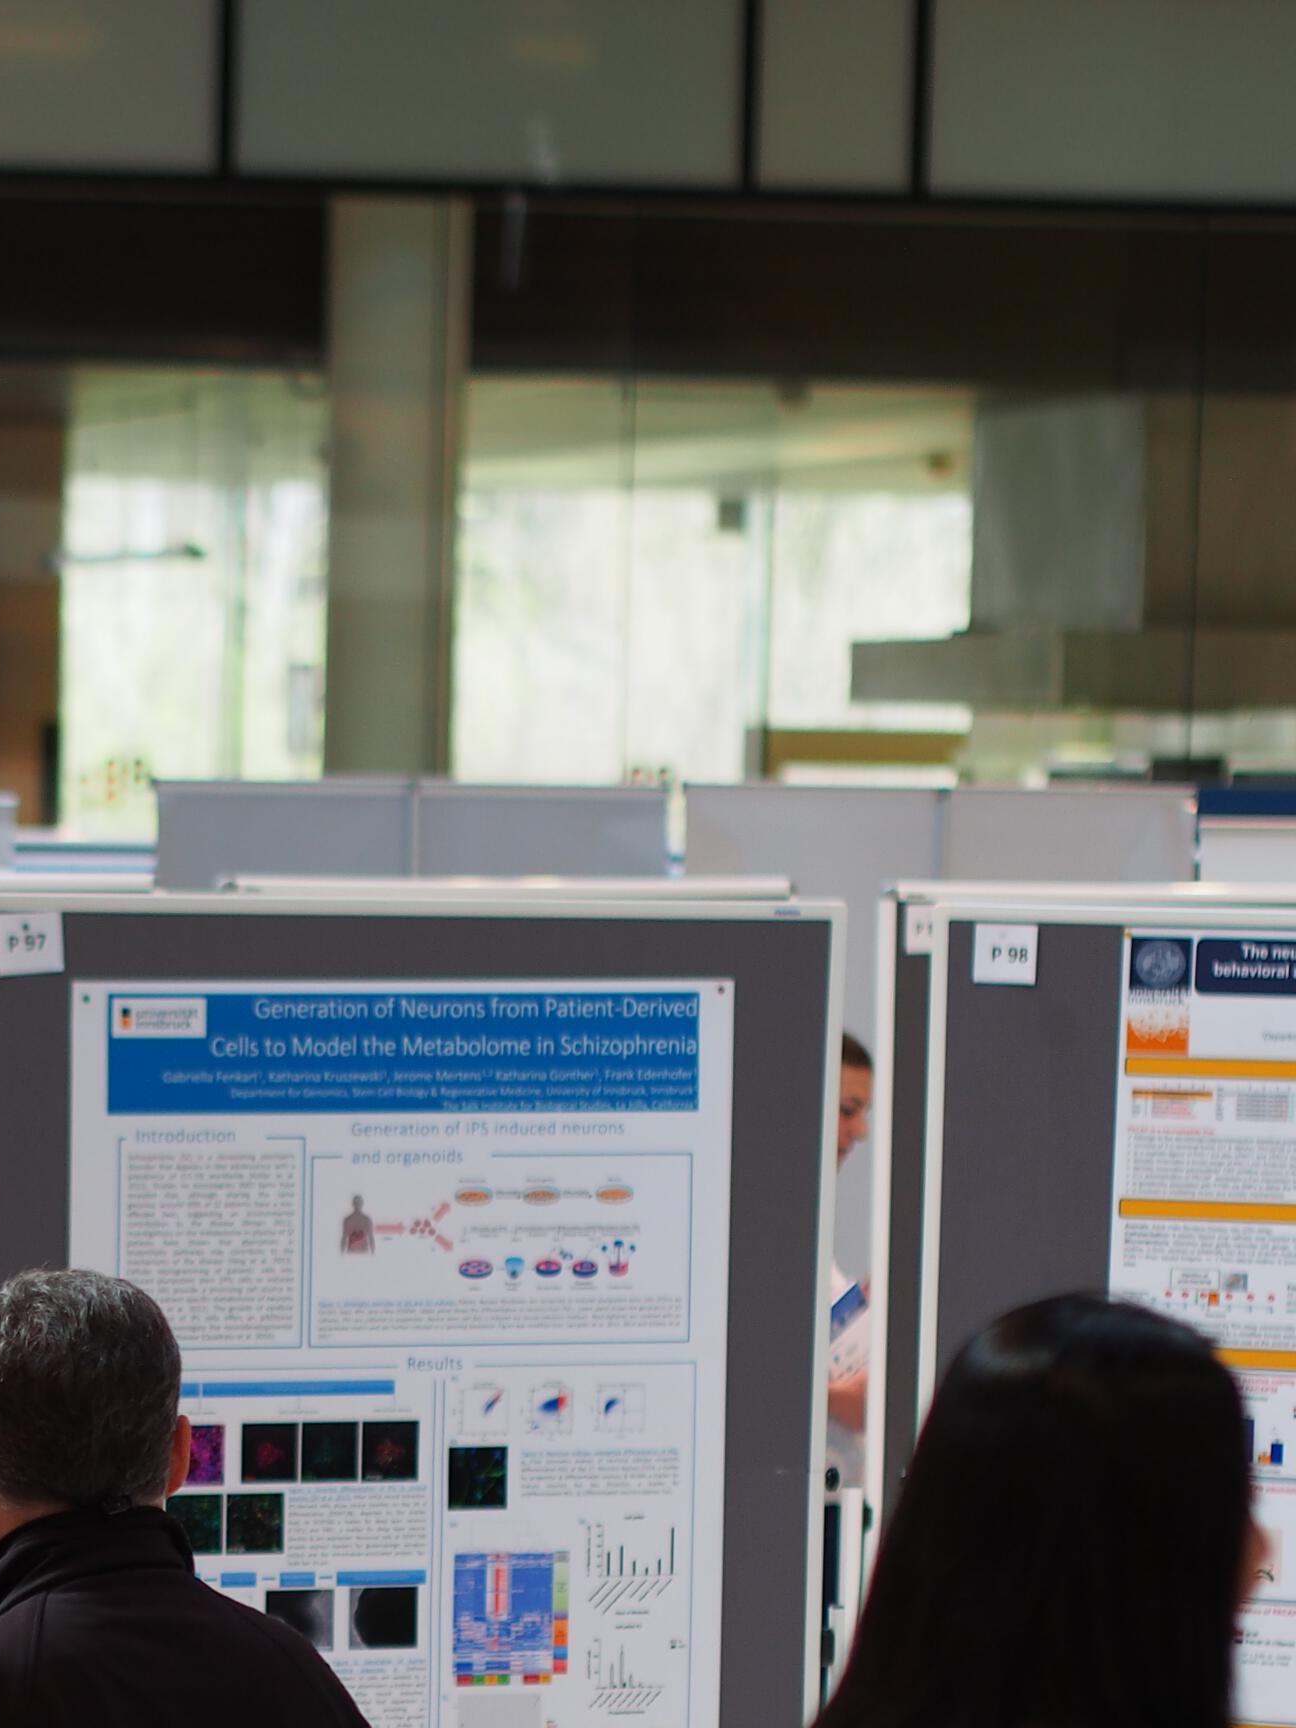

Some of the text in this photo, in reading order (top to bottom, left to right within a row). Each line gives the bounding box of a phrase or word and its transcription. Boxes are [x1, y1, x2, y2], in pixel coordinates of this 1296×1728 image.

[8, 933, 47, 953] P 97
[1241, 943, 1269, 961] The
[991, 945, 1029, 964] P 98
[1212, 961, 1290, 979] behavioral
[255, 997, 698, 1020] Generation of Neurons from Patient-Derived
[211, 1035, 697, 1060] Cells to Model the Metabolome in Schizophrenia
[135, 1127, 236, 1144] Introduction
[351, 1119, 625, 1138] Generation of iPS induced neurons
[351, 1149, 464, 1168] and organoids
[407, 1356, 464, 1372] Results
